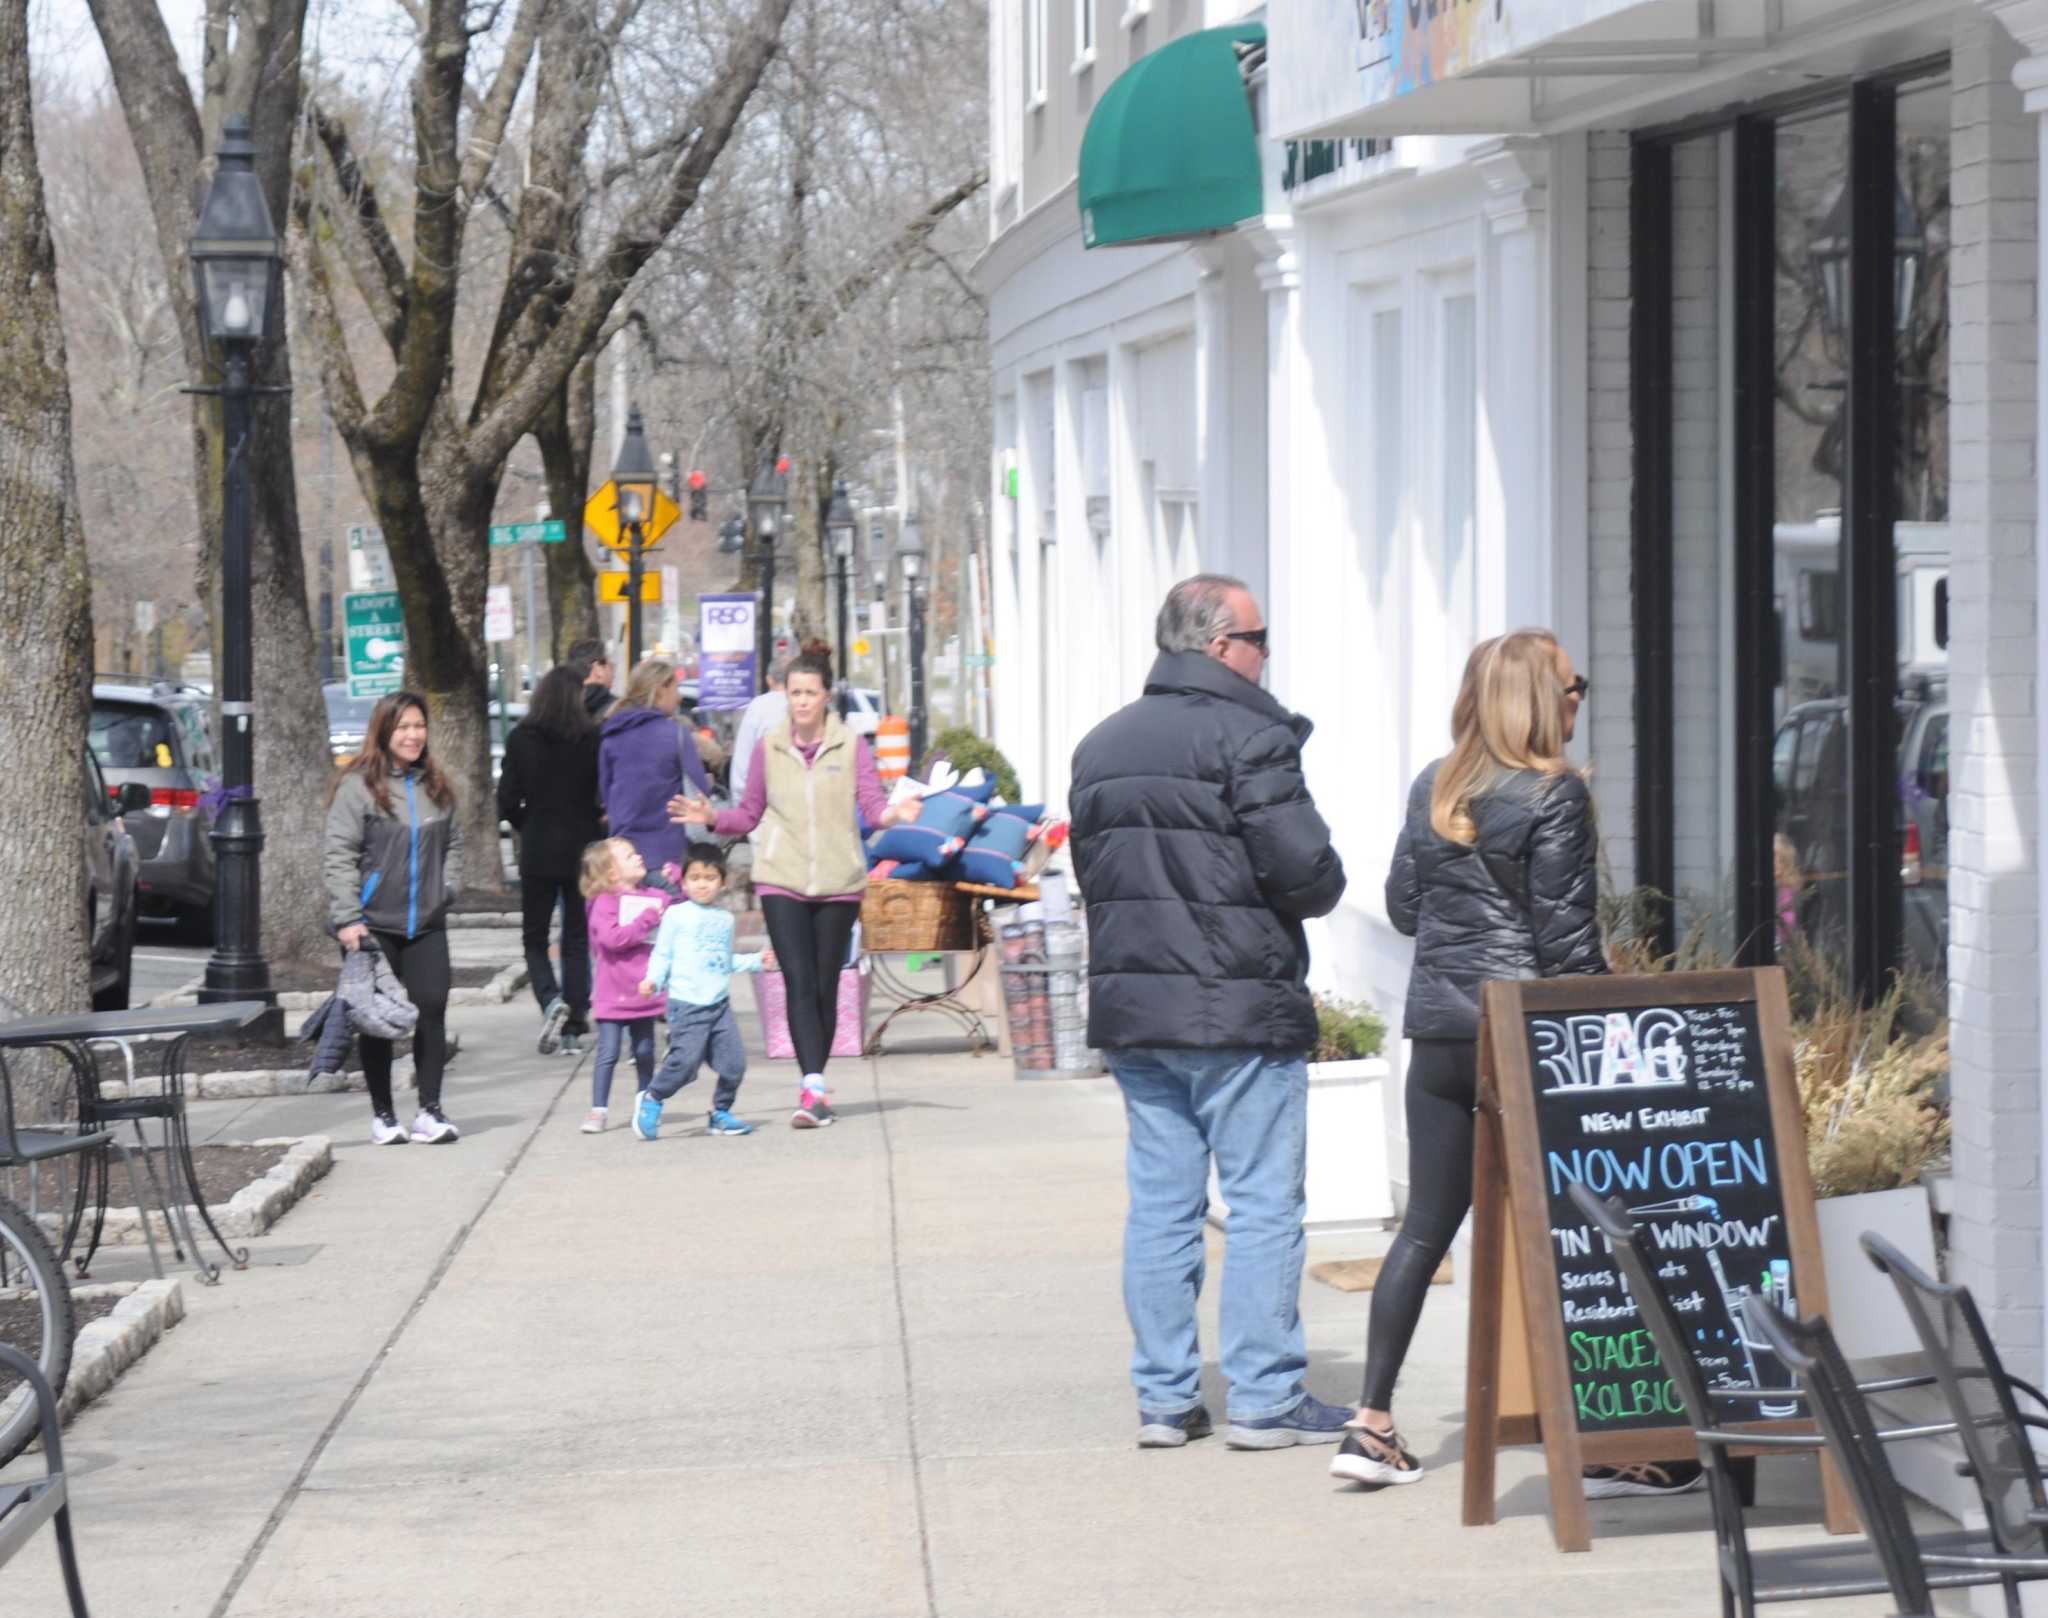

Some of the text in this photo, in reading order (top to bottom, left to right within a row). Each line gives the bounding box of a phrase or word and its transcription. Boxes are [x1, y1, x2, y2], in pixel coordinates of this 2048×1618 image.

[352, 596, 396, 610] ADOPT
[1580, 1107, 1711, 1133] NEW EXHIBIT
[1548, 1137, 1768, 1195] NOW OPEN
[1561, 1270, 1614, 1290] Series
